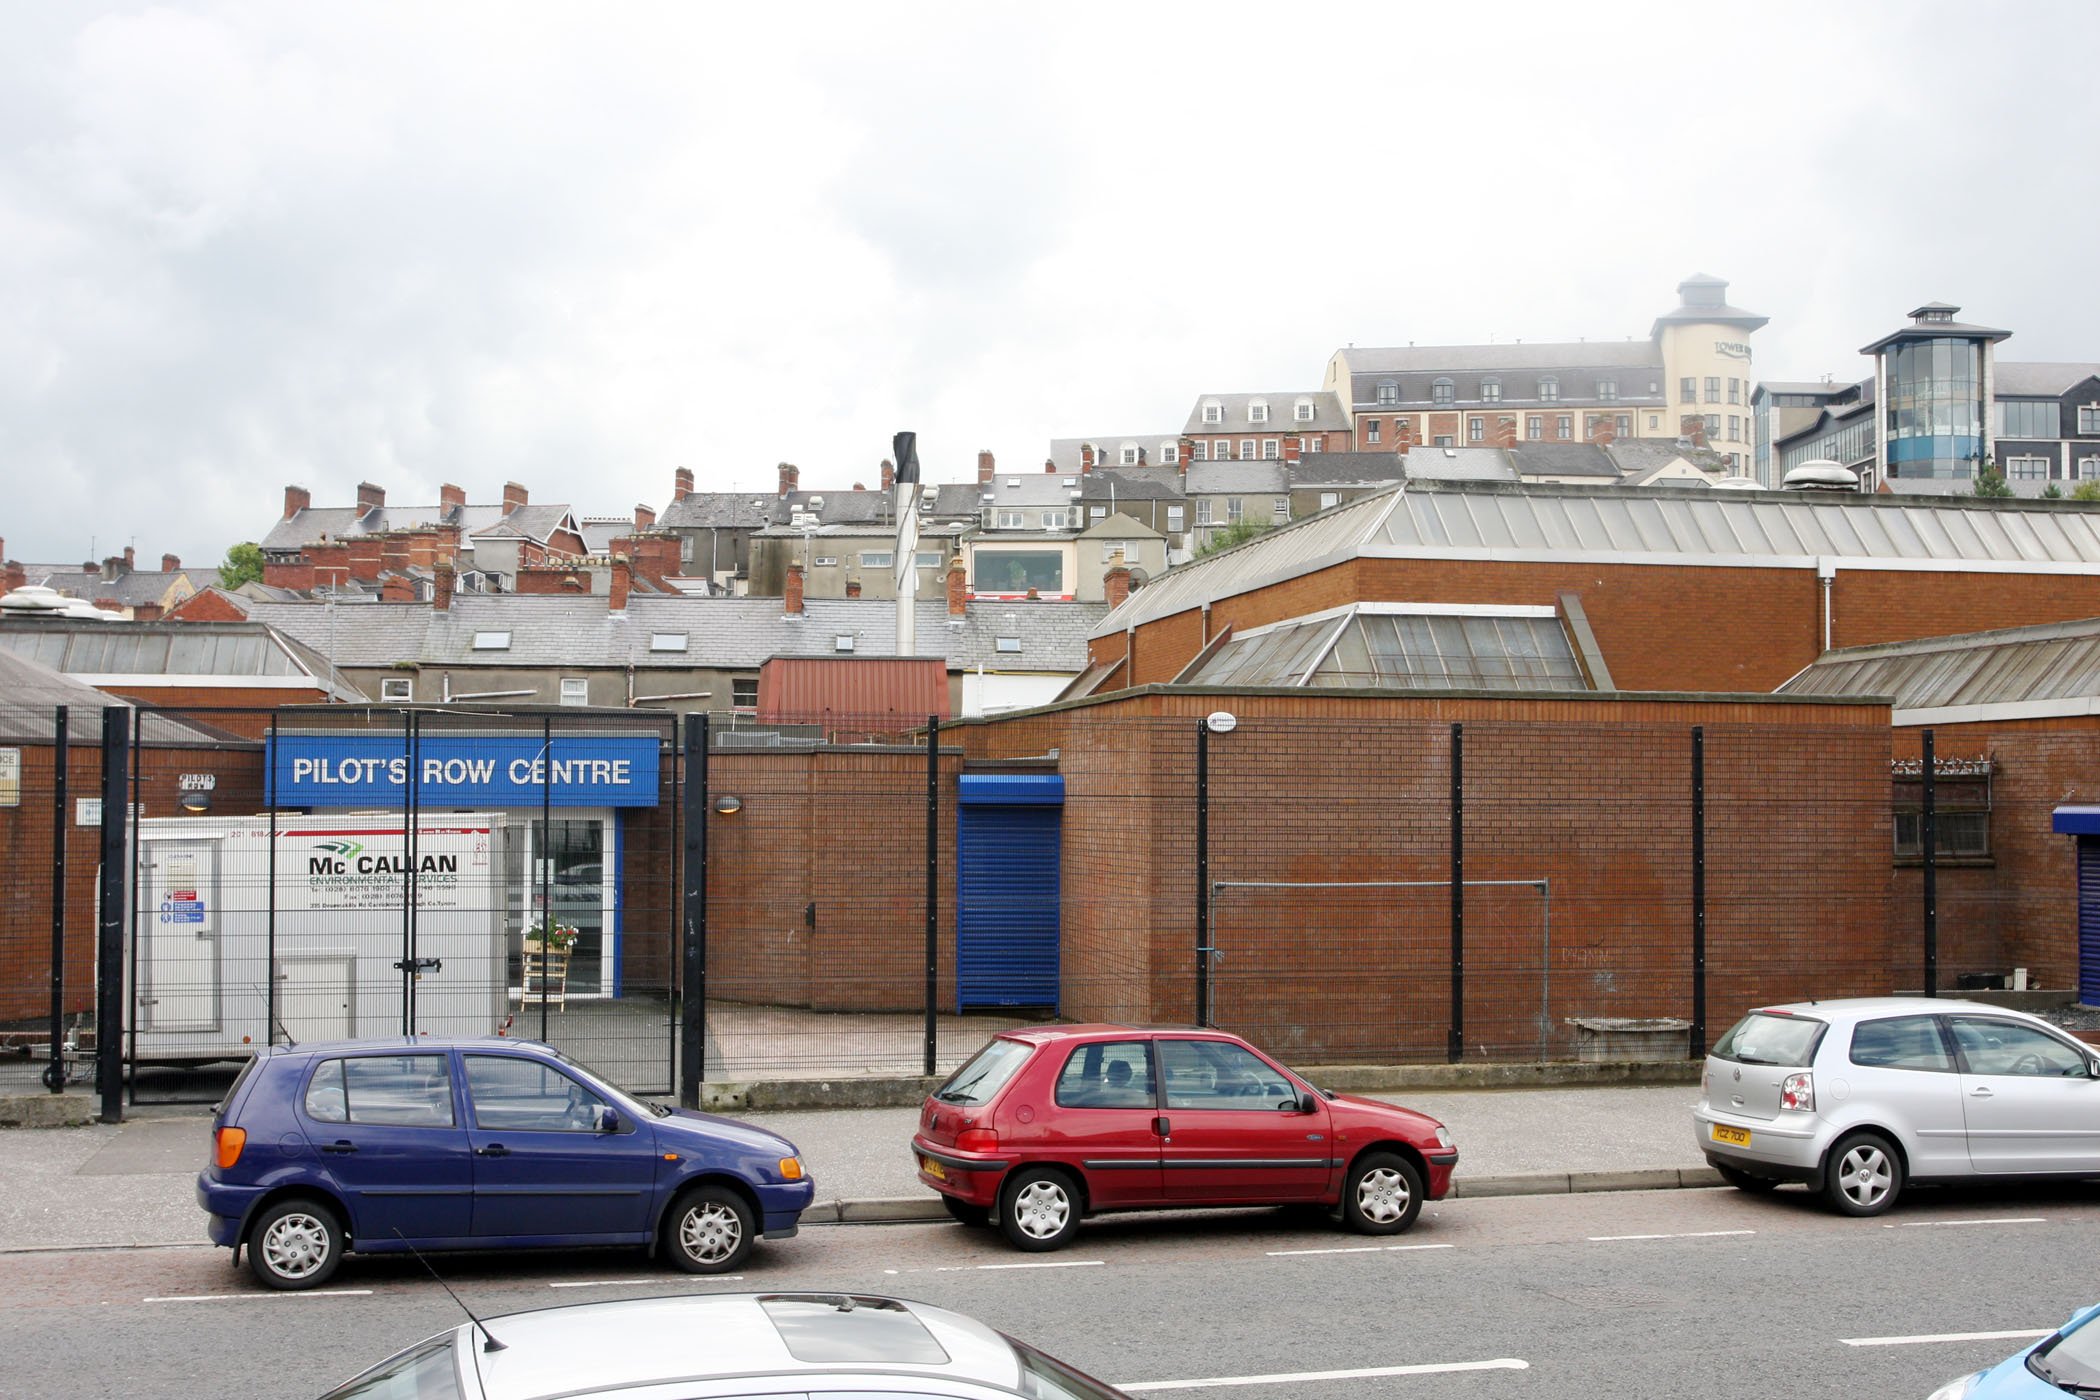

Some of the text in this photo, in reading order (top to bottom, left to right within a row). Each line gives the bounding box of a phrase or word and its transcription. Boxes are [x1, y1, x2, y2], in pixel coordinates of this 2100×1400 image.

[293, 758, 631, 786] PILOT'S ROW CENTRE
[309, 857, 346, 876] Mc
[309, 875, 400, 885] ENVIRONMENTAL
